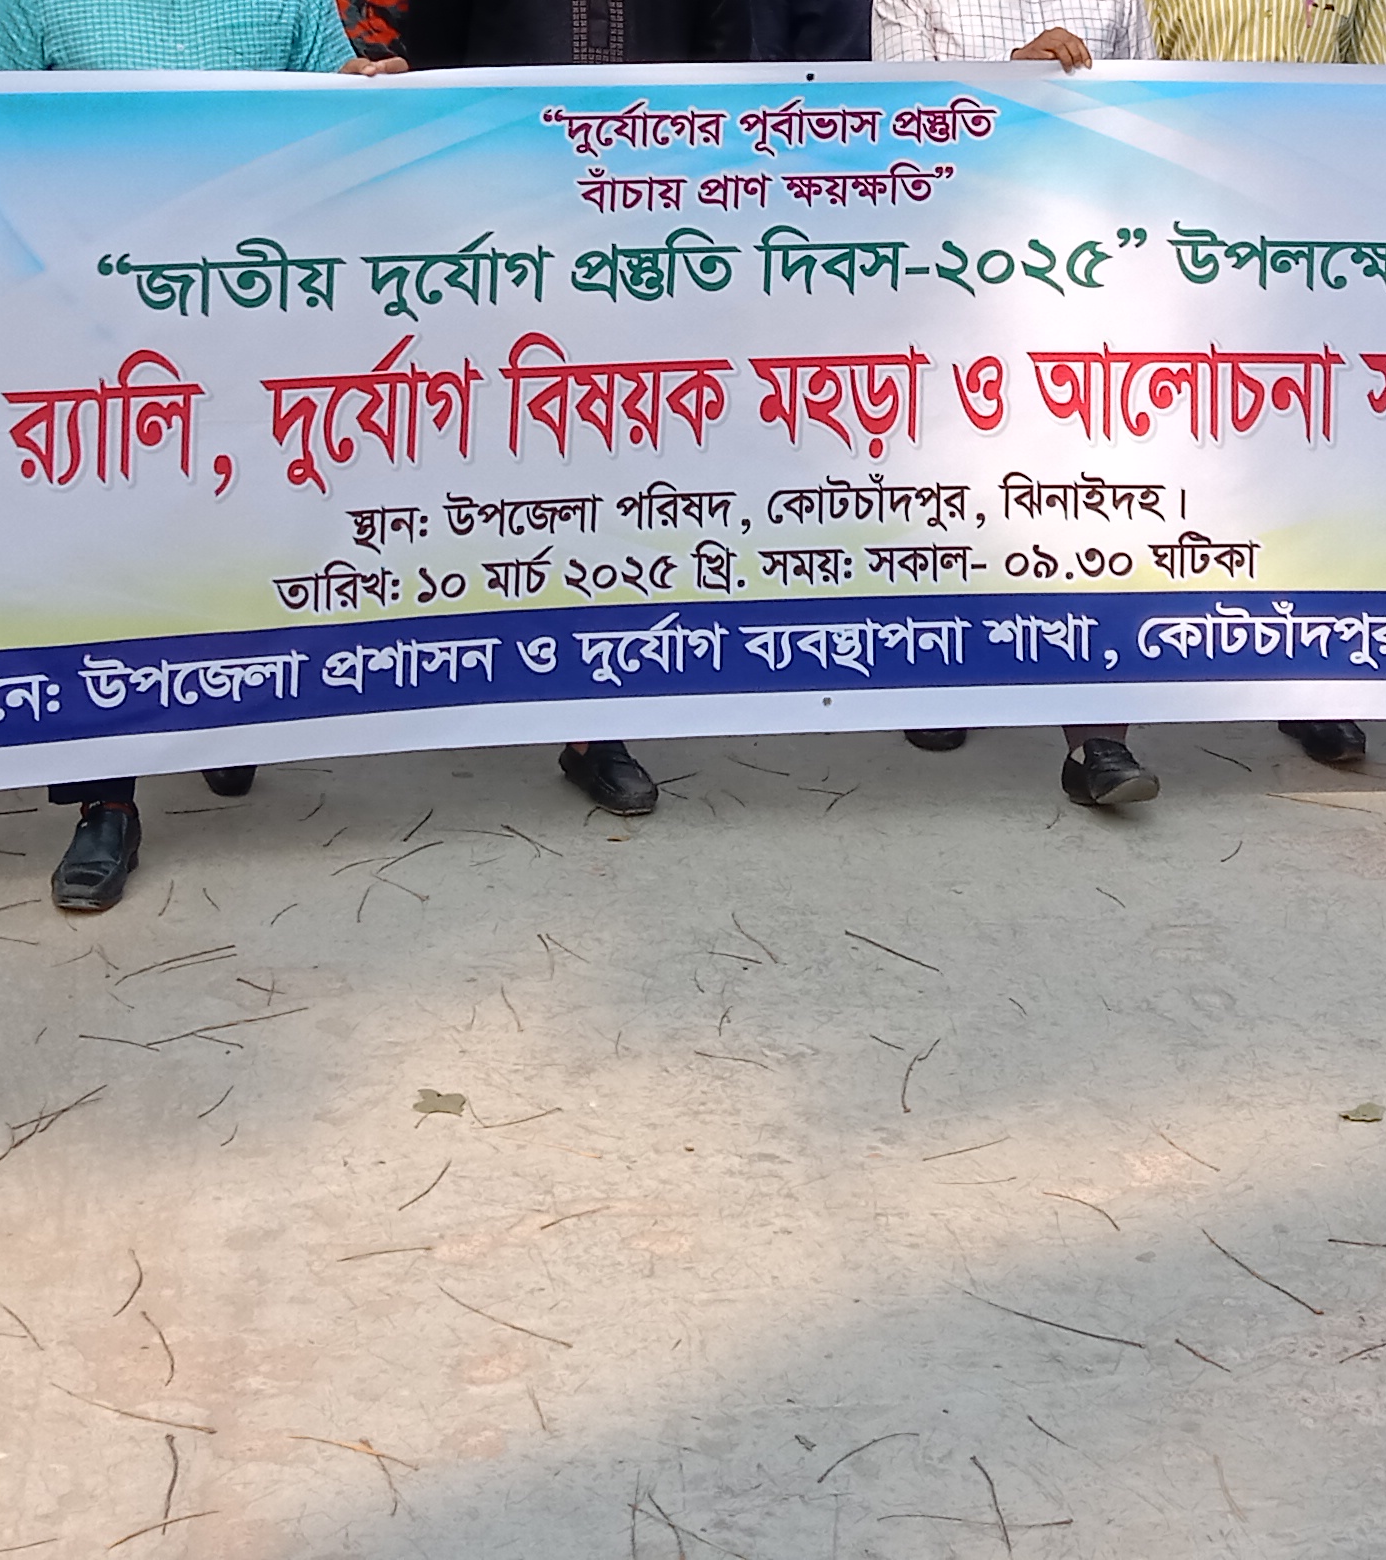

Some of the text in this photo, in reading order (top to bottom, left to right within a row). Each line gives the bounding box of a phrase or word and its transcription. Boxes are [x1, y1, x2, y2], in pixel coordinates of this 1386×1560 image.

[542, 97, 997, 158] “দুর্যোগের পূর্বাভাস প্রস্তুতি
[576, 161, 954, 214] বাঁচায় প্রাণ ক্ষয়ক্ষতি”
[97, 237, 347, 317] “জাতীয়
[360, 231, 555, 322] দুর্যোগ
[571, 227, 742, 303] প্রস্তুতি
[753, 224, 1147, 297] দিবস-২০২৫”
[261, 334, 483, 493] দুর্যোগ
[501, 331, 733, 453] বিষয়ক
[751, 346, 931, 459] মহড়া
[952, 355, 1004, 431] ও
[1026, 343, 1345, 439] আলোচনা
[345, 506, 429, 555] স্থান:
[442, 492, 604, 538] উপজেলা
[272, 559, 400, 613] তারিখ:
[417, 567, 466, 604] ১০
[481, 545, 554, 598] মার্চ
[564, 555, 678, 598] ২০২৫
[757, 548, 853, 586] সময়:
[864, 543, 987, 583] সকাল-
[1004, 544, 1133, 580] ০৯.৩০
[1147, 530, 1261, 579] ঘটিকা
[77, 649, 310, 708] উপজেলা
[322, 638, 503, 694] প্রশাসন
[516, 636, 557, 673] ও
[572, 612, 730, 687] দুর্যোগ
[738, 615, 973, 678] ব্যবস্থাপনা
